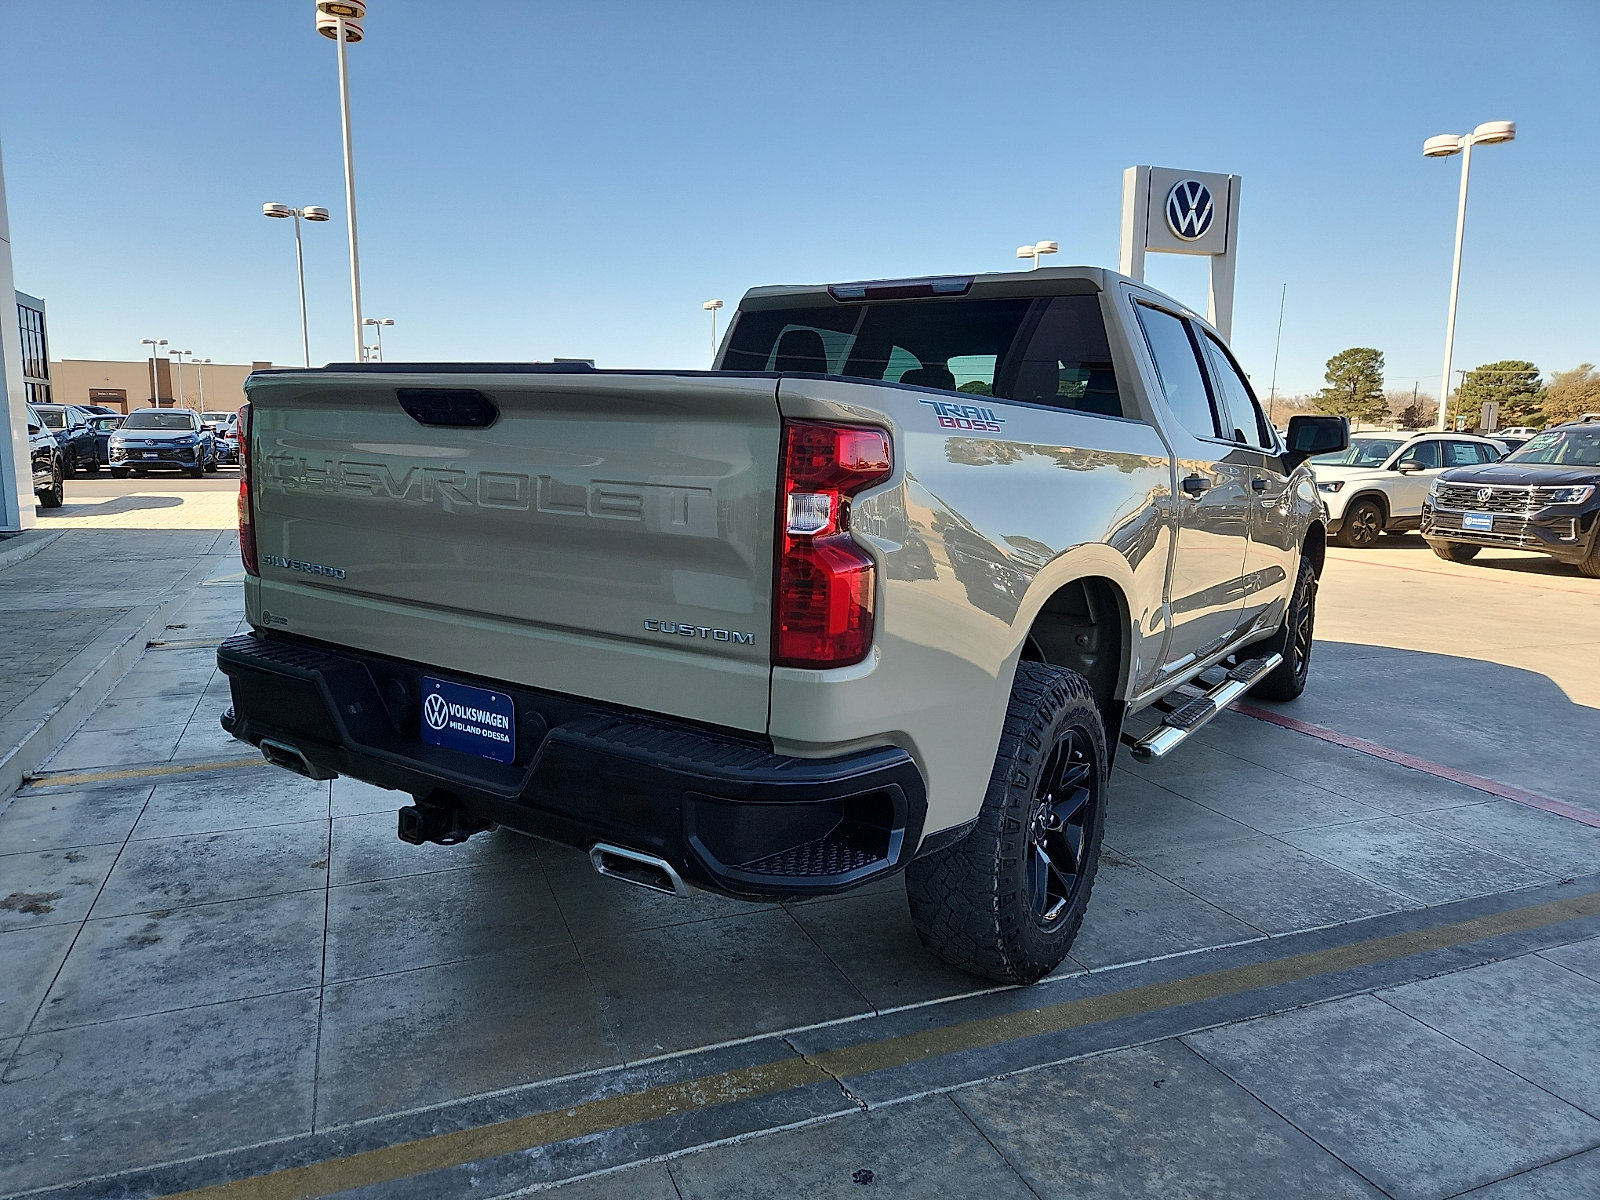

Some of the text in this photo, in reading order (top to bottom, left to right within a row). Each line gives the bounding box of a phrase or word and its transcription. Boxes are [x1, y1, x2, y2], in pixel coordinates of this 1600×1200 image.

[1167, 180, 1214, 241] VW
[918, 399, 1006, 424] TRAIL
[937, 415, 1002, 433] BOSS
[264, 455, 713, 526] CHEVROLET
[262, 553, 347, 580] SILVERADO
[643, 618, 756, 646] CUSTOM
[424, 693, 449, 730] VW
[448, 702, 510, 730] VOLKSWAGEN
[449, 720, 510, 744] MIDLAND ODESSA
